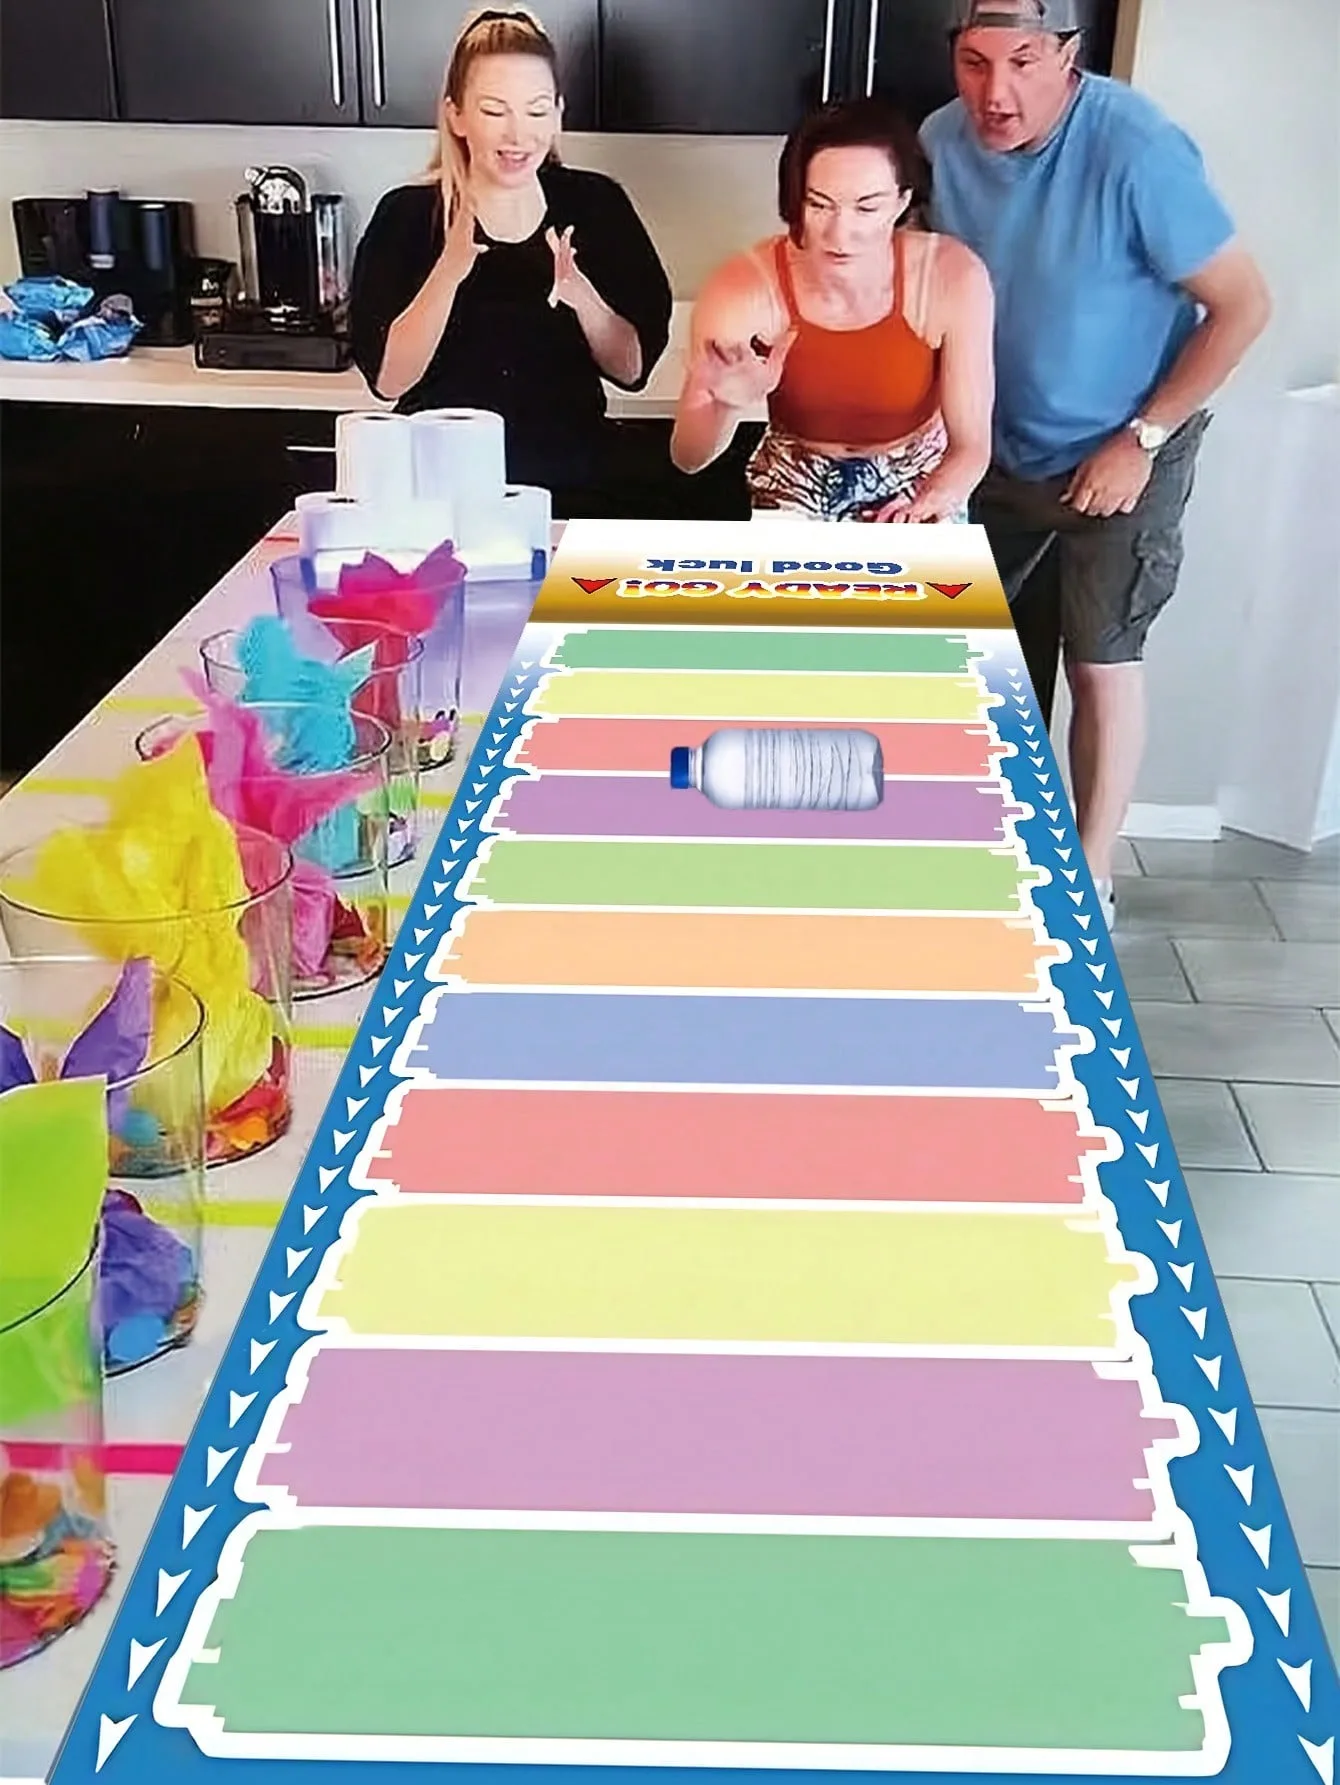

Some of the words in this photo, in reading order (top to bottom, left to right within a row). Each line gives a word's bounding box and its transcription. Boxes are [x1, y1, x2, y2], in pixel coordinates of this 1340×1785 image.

[646, 558, 754, 573] luck
[771, 559, 904, 575] Good
[622, 578, 720, 598] GO!
[734, 580, 921, 599] READY
